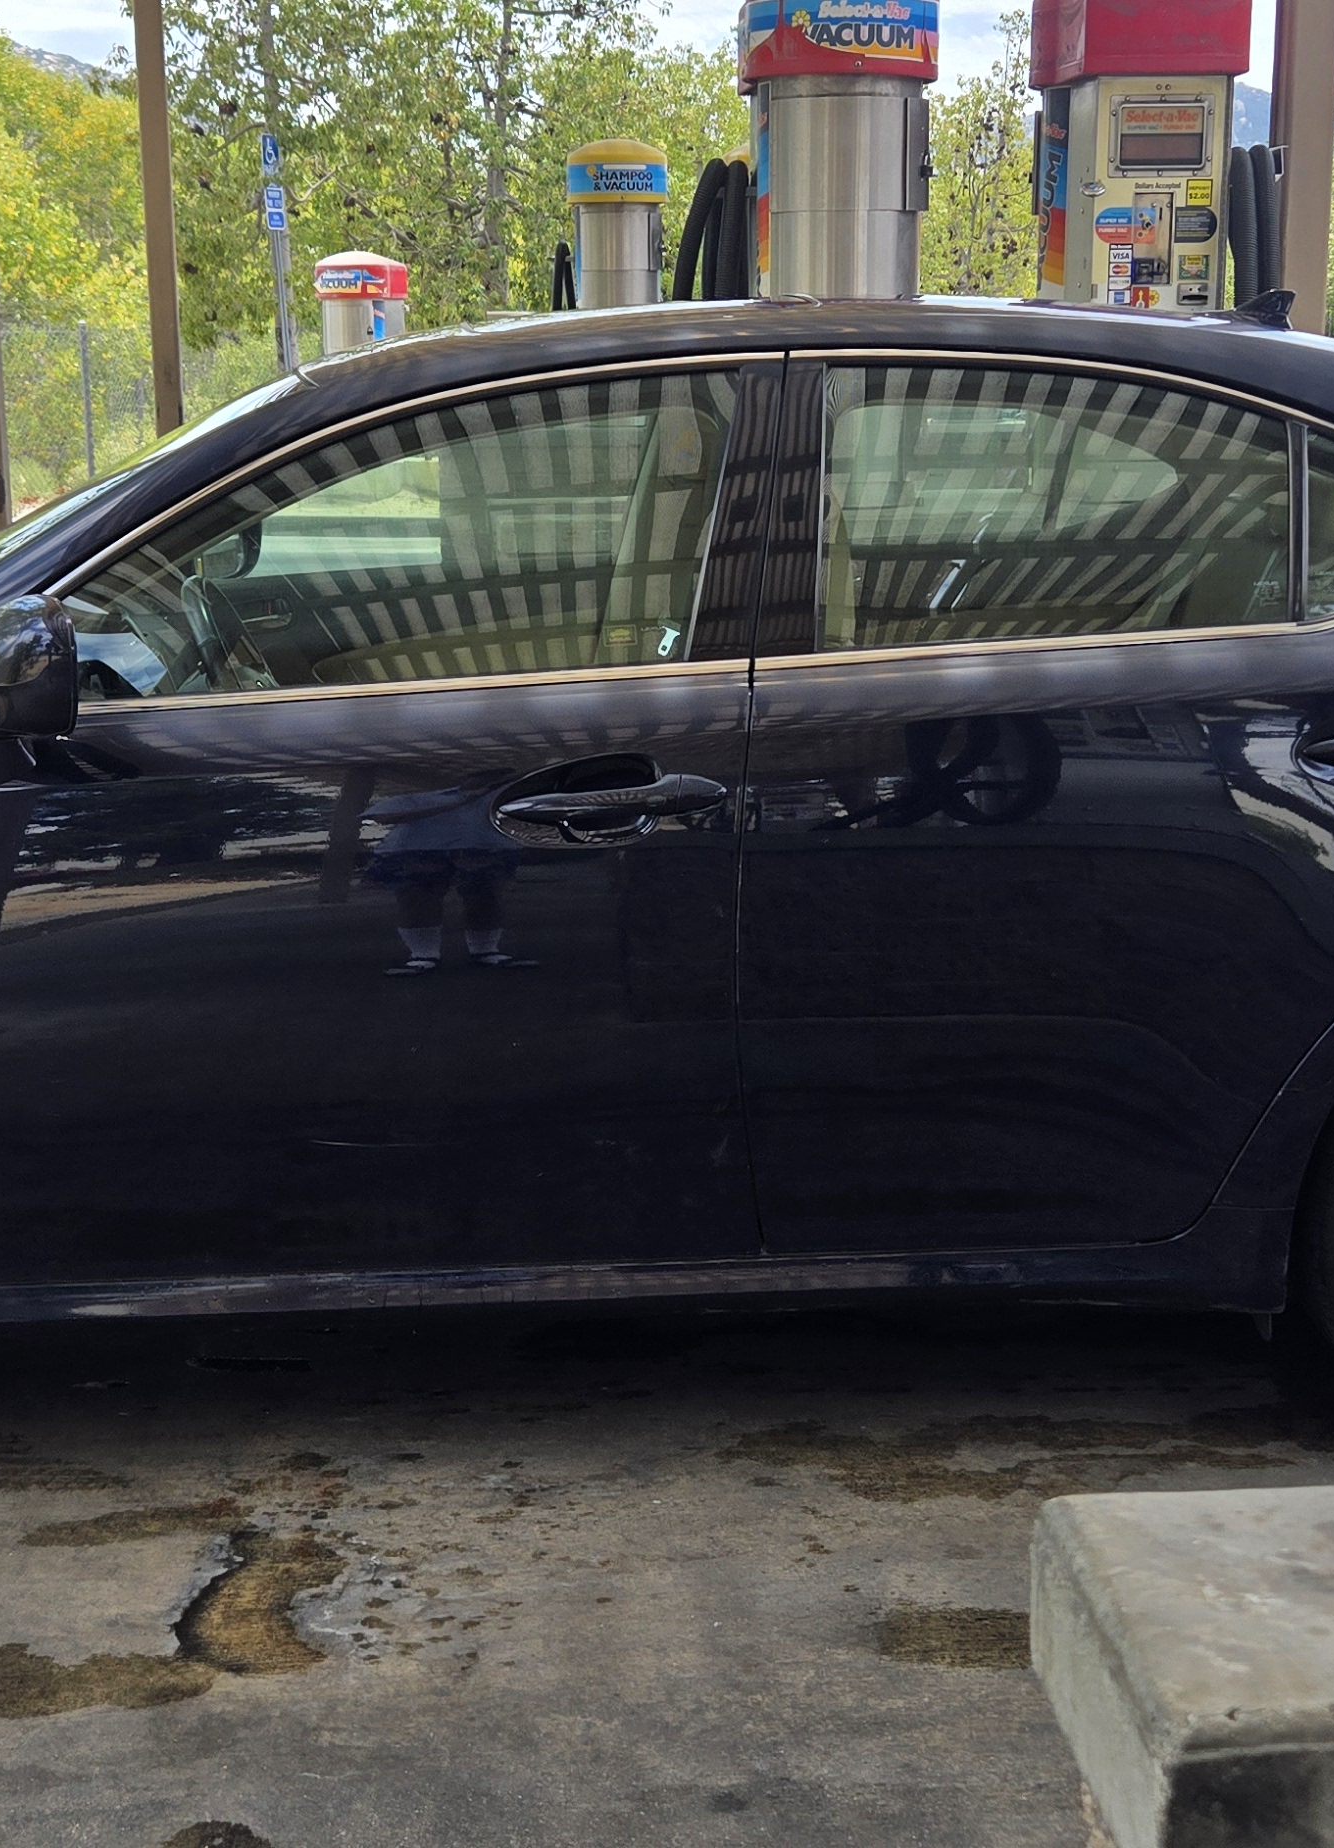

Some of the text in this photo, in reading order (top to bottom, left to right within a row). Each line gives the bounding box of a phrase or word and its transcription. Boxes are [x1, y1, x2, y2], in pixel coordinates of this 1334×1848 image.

[593, 171, 653, 181] SHAMPOO
[593, 181, 653, 191] & VACUUM
[1134, 182, 1181, 190] Dollars Accepted
